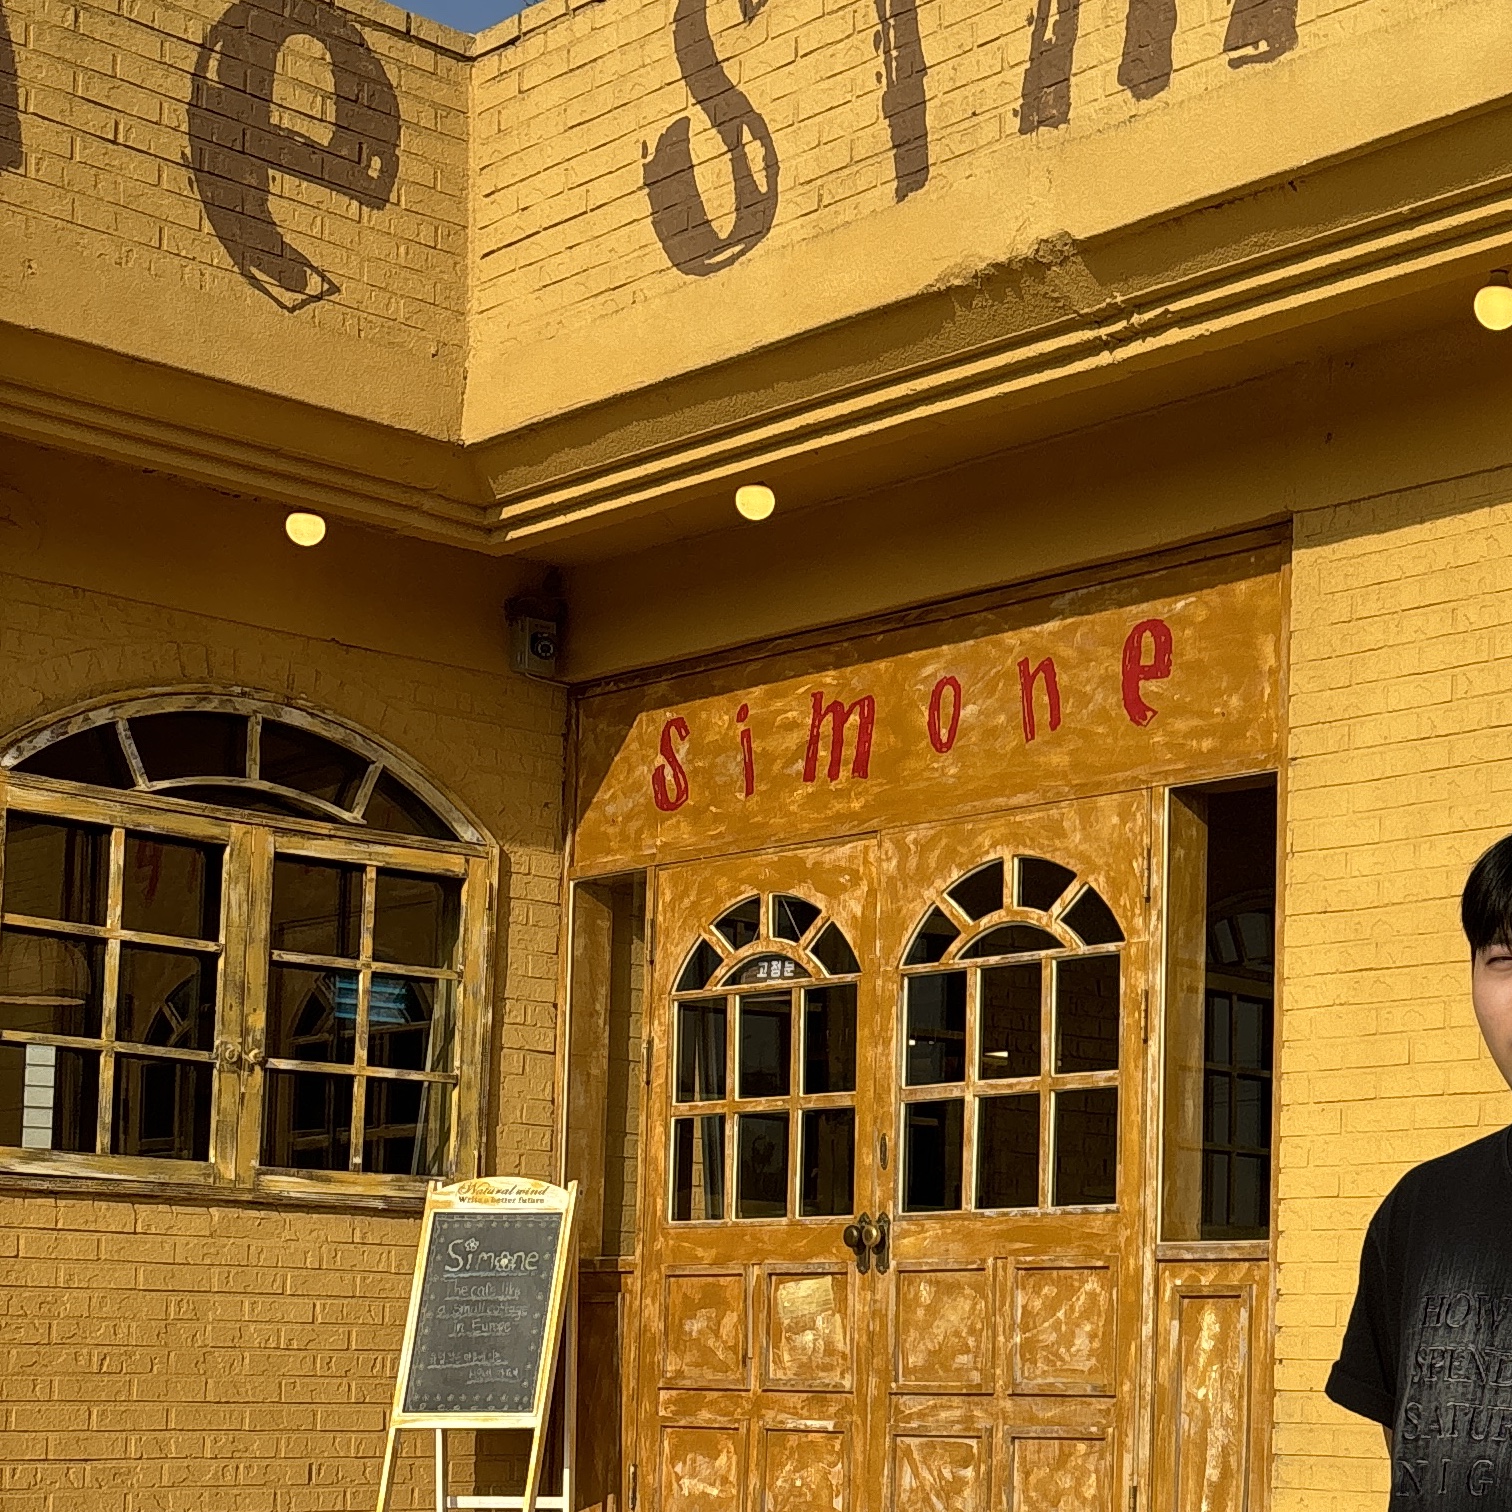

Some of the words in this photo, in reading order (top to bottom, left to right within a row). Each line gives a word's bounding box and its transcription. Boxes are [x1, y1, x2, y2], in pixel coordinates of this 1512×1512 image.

[652, 618, 1174, 812] simone
[457, 1182, 517, 1196] Natural
[516, 1186, 550, 1196] wind
[445, 1238, 539, 1272] Simone
